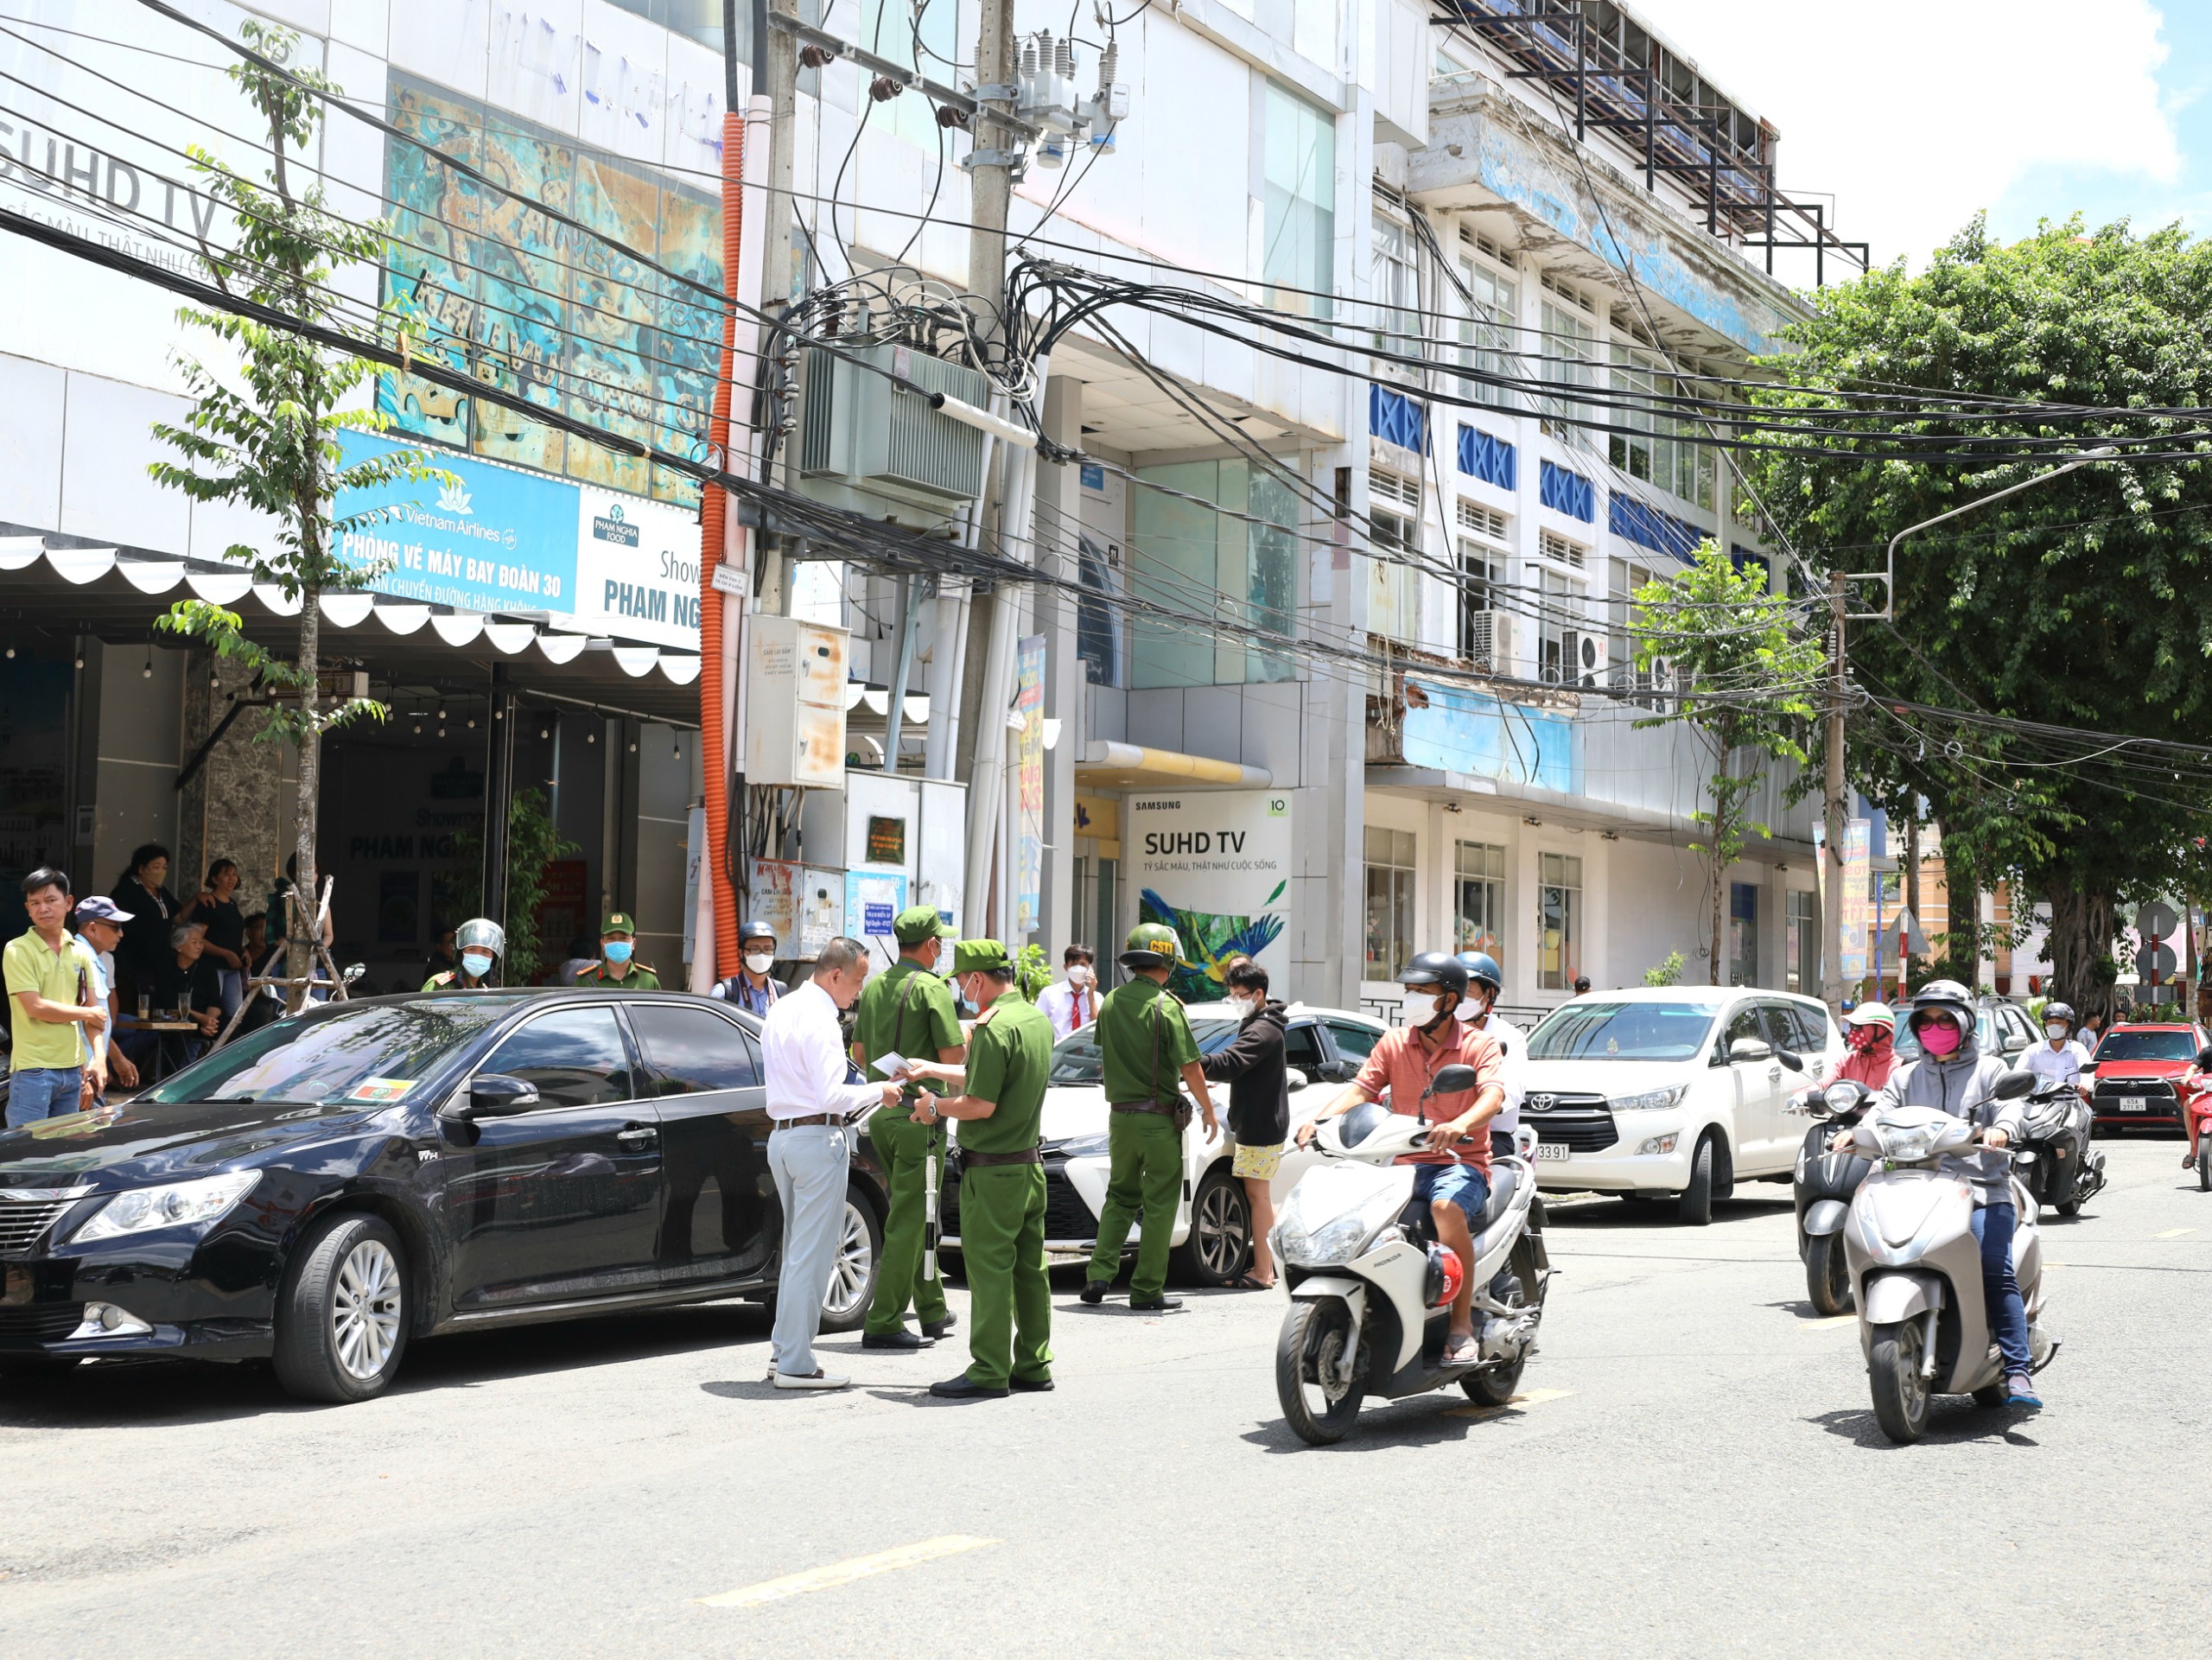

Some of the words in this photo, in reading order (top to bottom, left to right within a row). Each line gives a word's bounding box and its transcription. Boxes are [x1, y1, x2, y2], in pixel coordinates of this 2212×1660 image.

[0, 121, 141, 215] SUHD
[156, 173, 219, 242] TV
[406, 508, 456, 531] Vietnam
[457, 518, 499, 542] Airlines
[594, 519, 616, 532] PHAM
[616, 524, 638, 537] NGHIA
[607, 531, 626, 544] FOOD
[342, 531, 399, 563] PHÒNG
[404, 543, 423, 570] VÉ
[428, 549, 463, 578] MÁY
[467, 557, 496, 585] BAY
[499, 563, 540, 595] ĐOÀN
[543, 574, 561, 598] 30
[435, 584, 471, 606] ĐƯỜNG
[474, 590, 501, 612] HÀNG
[604, 578, 667, 623] PHAM
[416, 808, 486, 827] Showroo
[1135, 800, 1181, 811] SAMSUNG
[351, 836, 413, 860] PHAM
[1145, 831, 1211, 855] SUHD
[1217, 830, 1246, 854] TV
[1154, 859, 1169, 872] SẮC
[1192, 861, 1211, 873] THẬT
[1211, 862, 1230, 871] NHƯ
[1230, 860, 1253, 873] CUỘC
[1254, 858, 1277, 870] SỐNG
